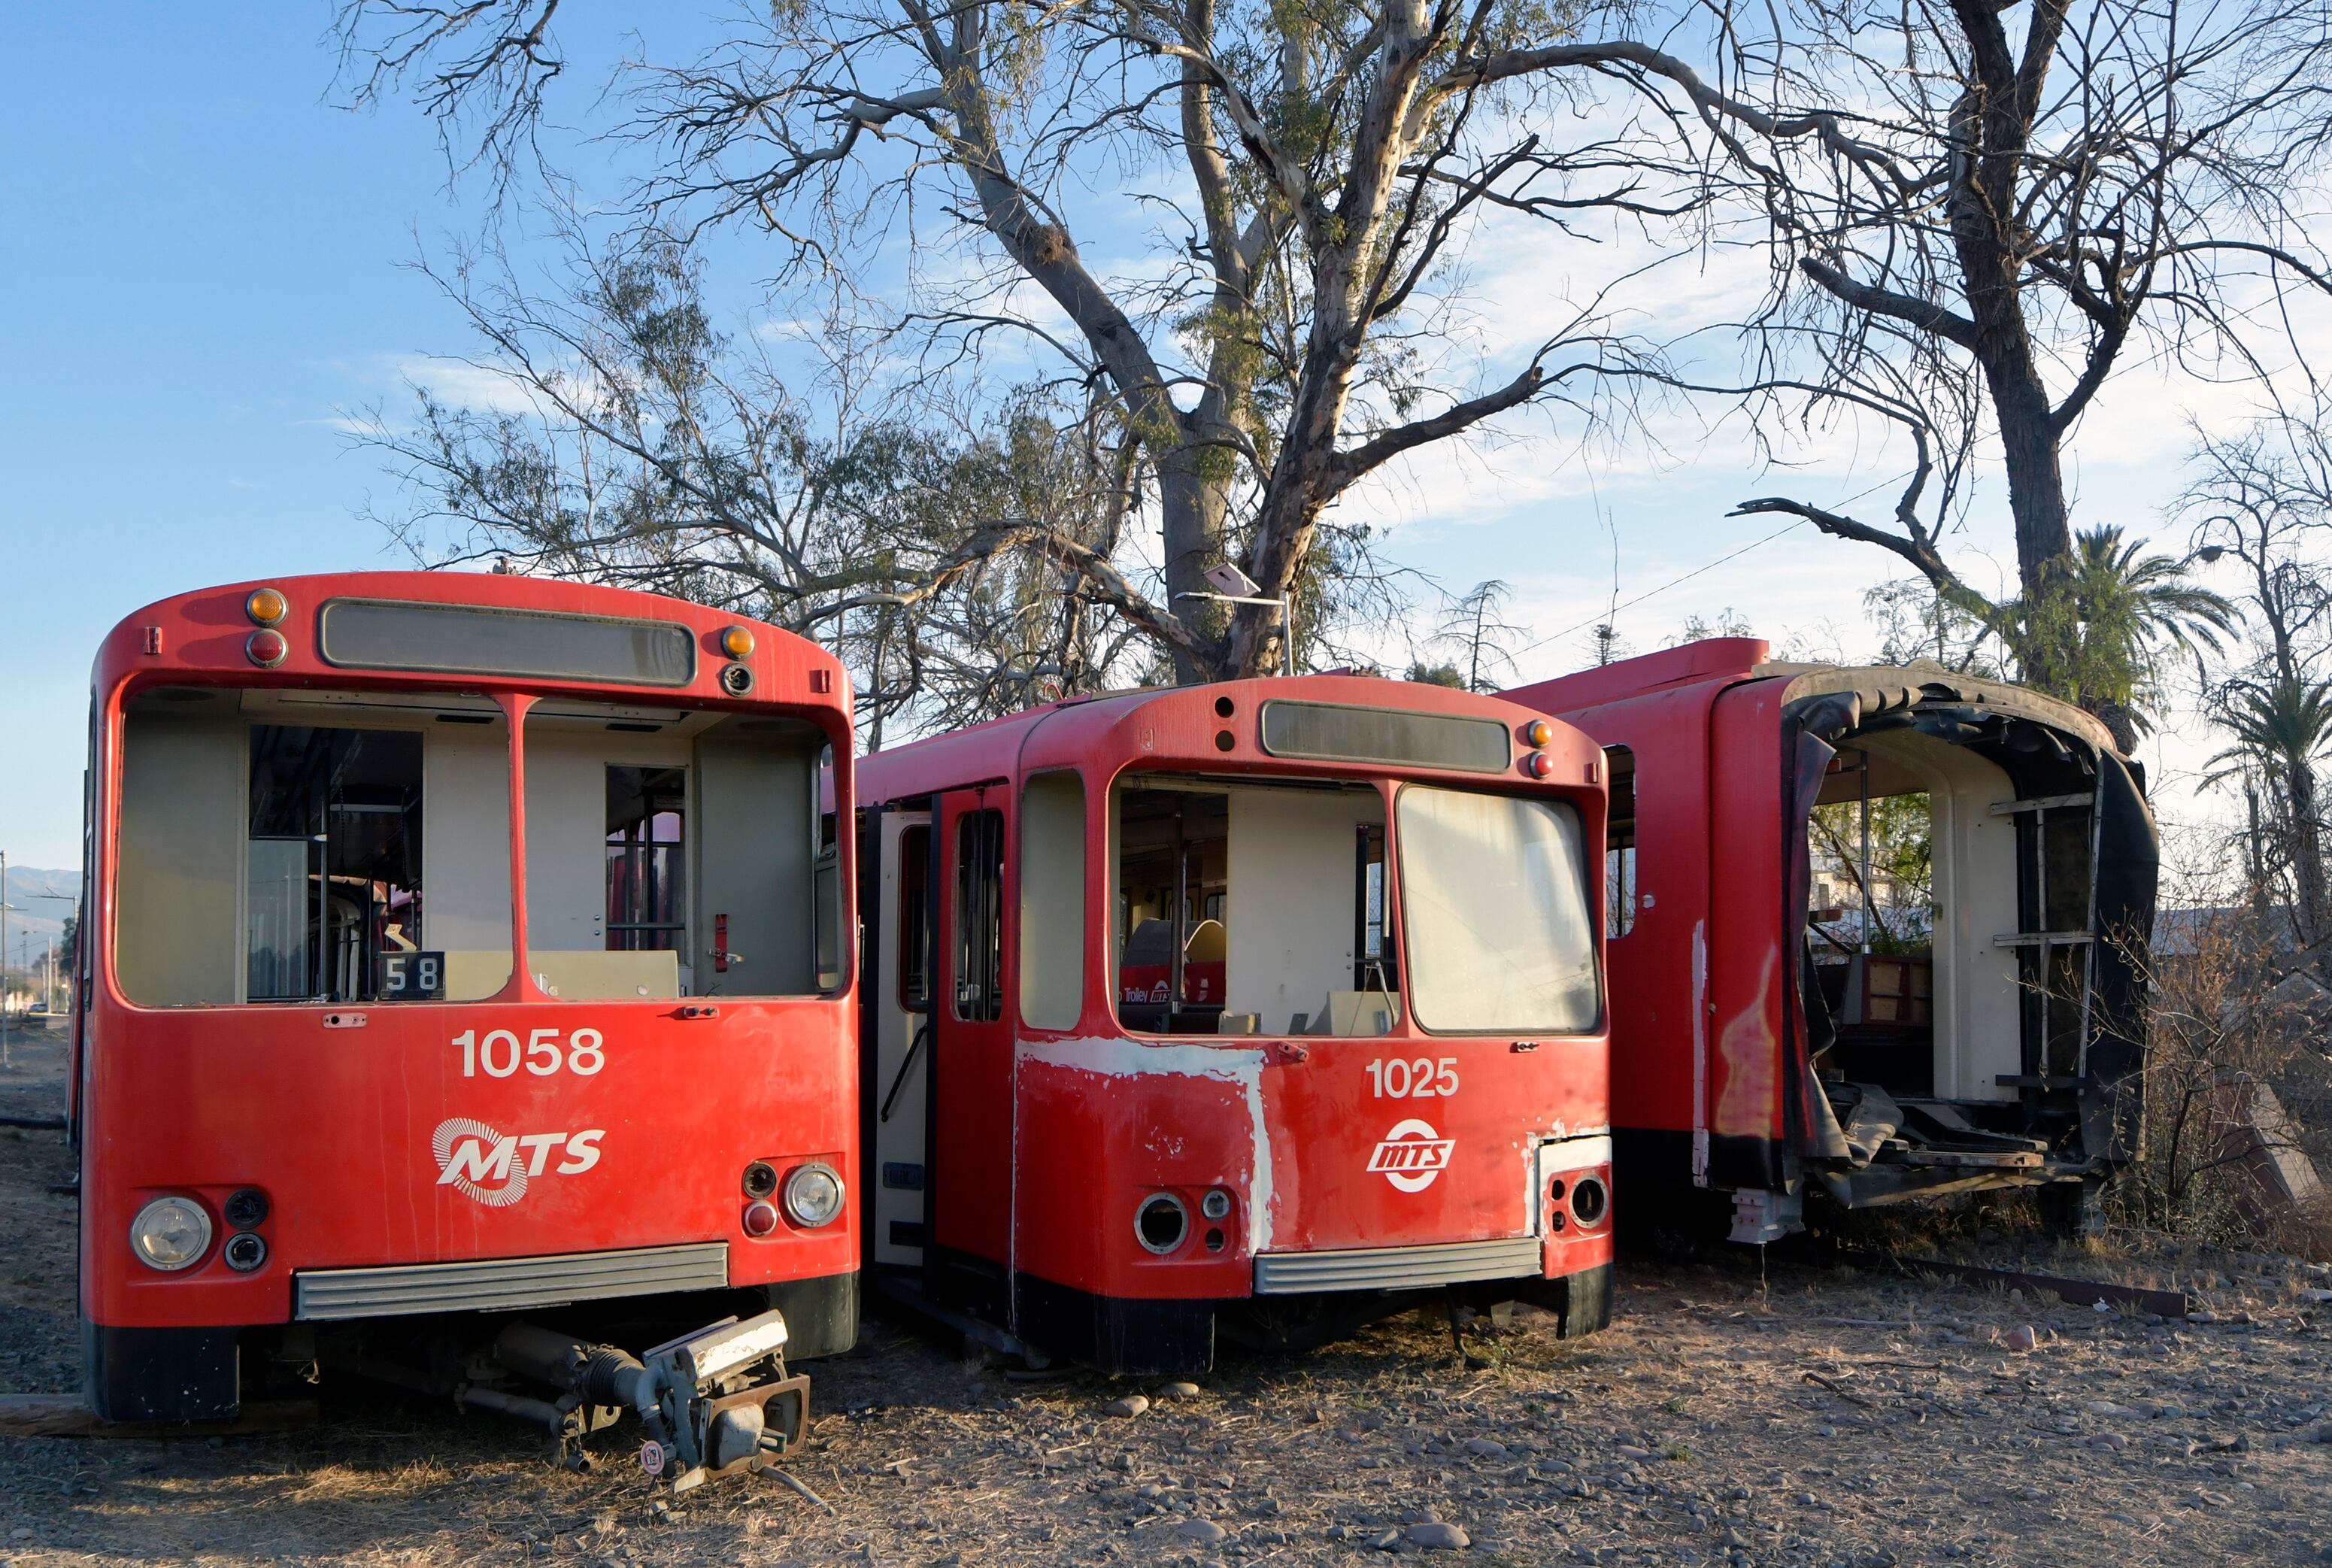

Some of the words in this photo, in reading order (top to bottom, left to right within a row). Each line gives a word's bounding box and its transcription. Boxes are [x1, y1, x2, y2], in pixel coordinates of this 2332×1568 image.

[1124, 987, 1148, 1002] Trolley
[451, 1028, 605, 1078] 1058
[1366, 1057, 1459, 1098] 1025
[436, 1129, 606, 1184] MTS
